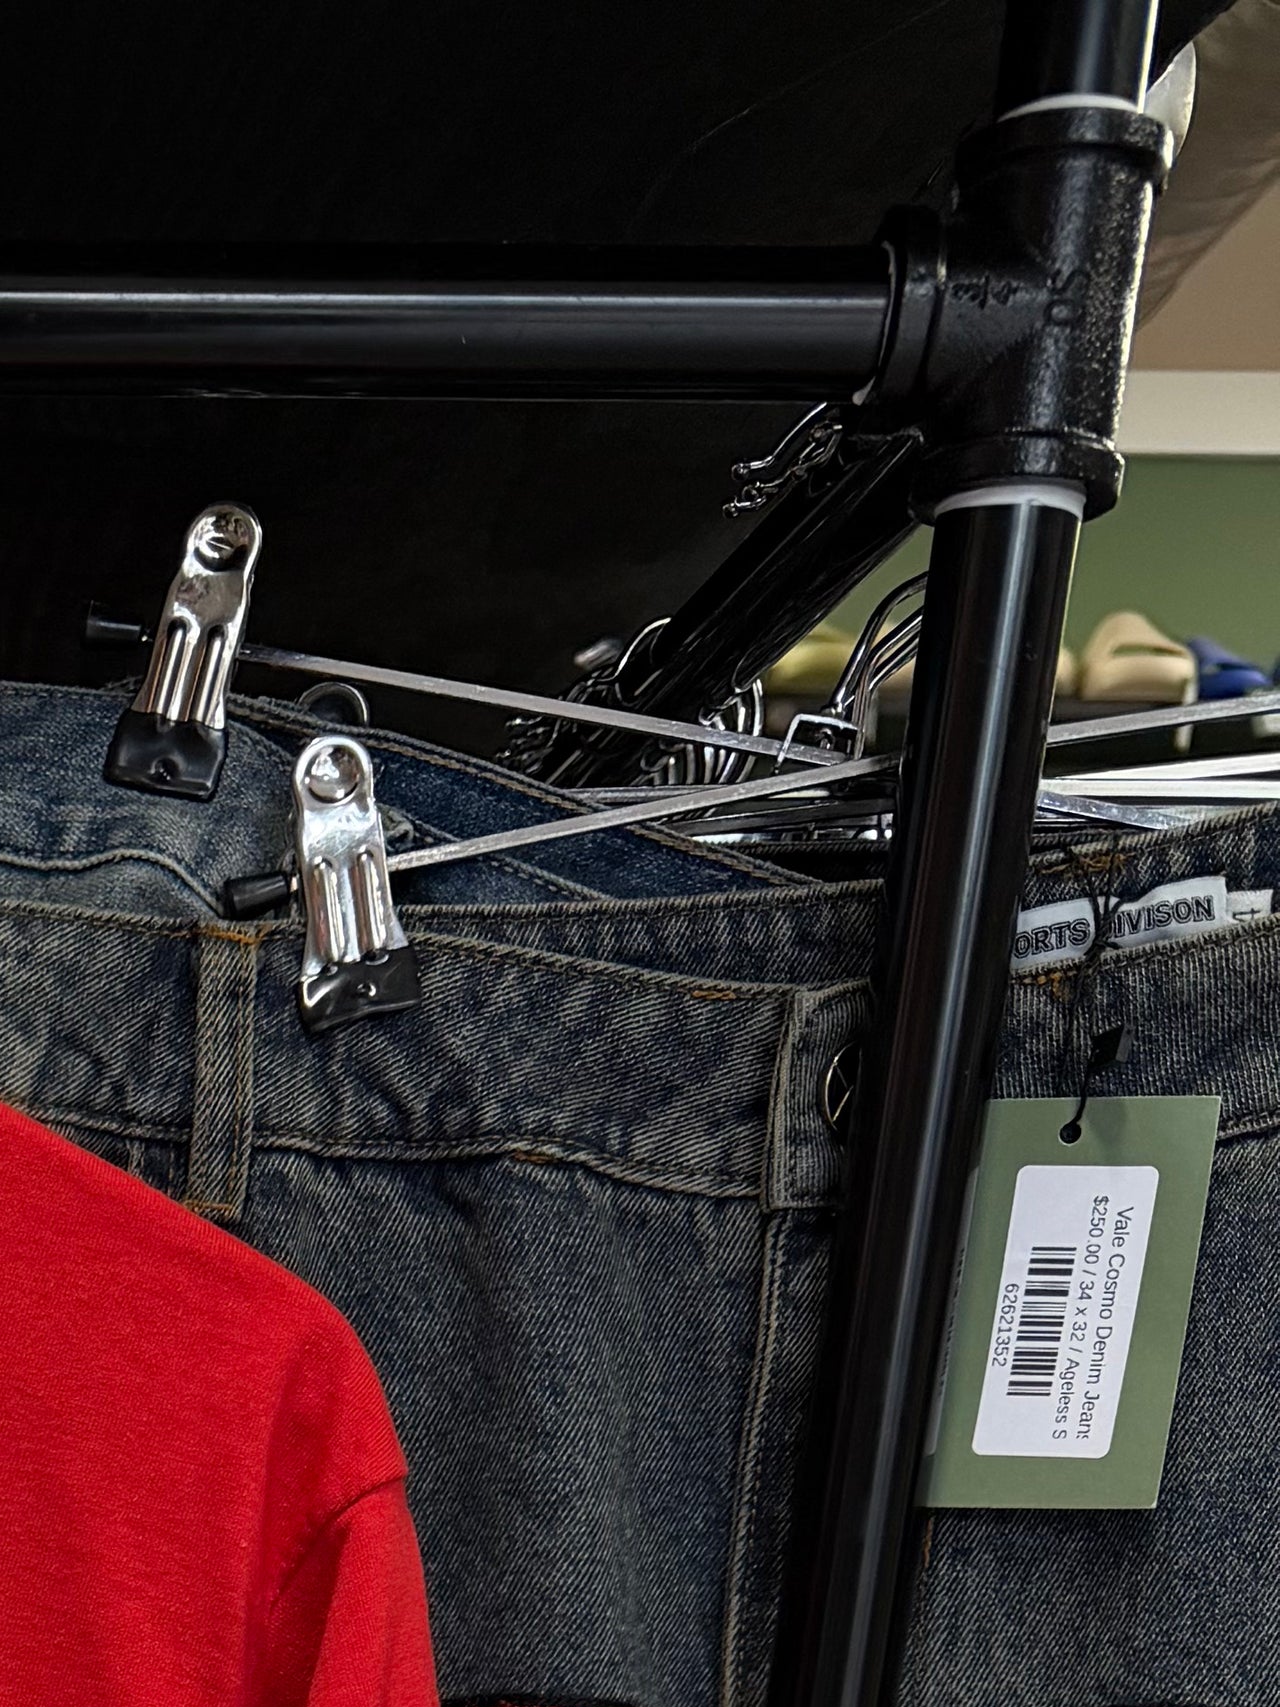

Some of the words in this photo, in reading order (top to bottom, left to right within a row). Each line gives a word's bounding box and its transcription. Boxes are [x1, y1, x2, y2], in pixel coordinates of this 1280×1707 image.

[1084, 1195, 1110, 1265] $250.00
[1111, 1205, 1135, 1248] Vale
[1075, 1306, 1088, 1317] x
[1077, 1280, 1095, 1301] 34
[1099, 1253, 1126, 1320] Cosmo
[992, 1282, 1020, 1367] 62621352
[1070, 1321, 1088, 1342] 32
[1086, 1325, 1114, 1384] Denim
[1054, 1357, 1081, 1424] Ageless
[1052, 1429, 1067, 1440] S
